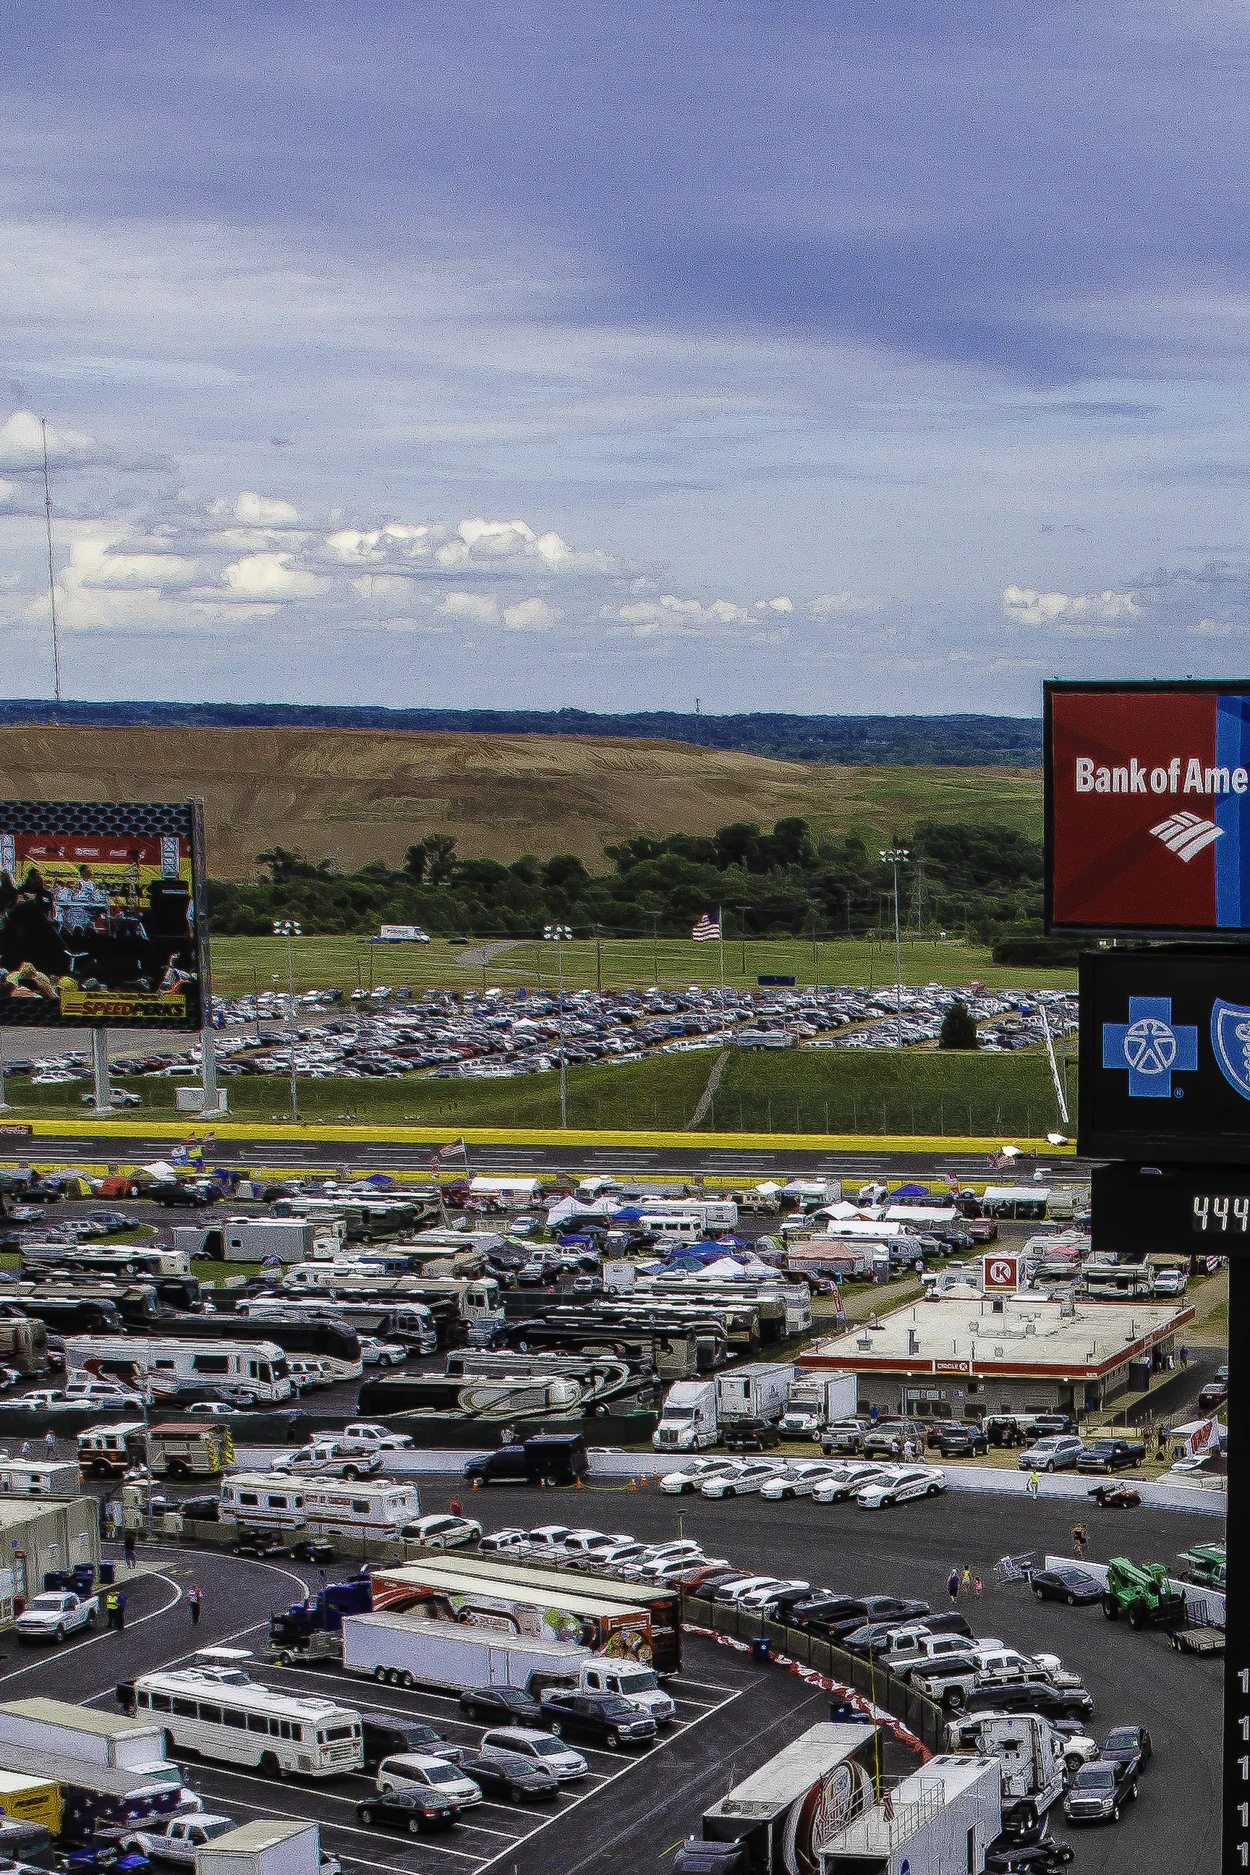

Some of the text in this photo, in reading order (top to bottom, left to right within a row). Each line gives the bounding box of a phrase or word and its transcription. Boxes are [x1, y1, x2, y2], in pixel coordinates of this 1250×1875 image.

[1076, 757, 1147, 795] Bank
[1151, 756, 1181, 794] of
[1194, 1197, 1249, 1231] 444
[992, 1263, 1010, 1283] K
